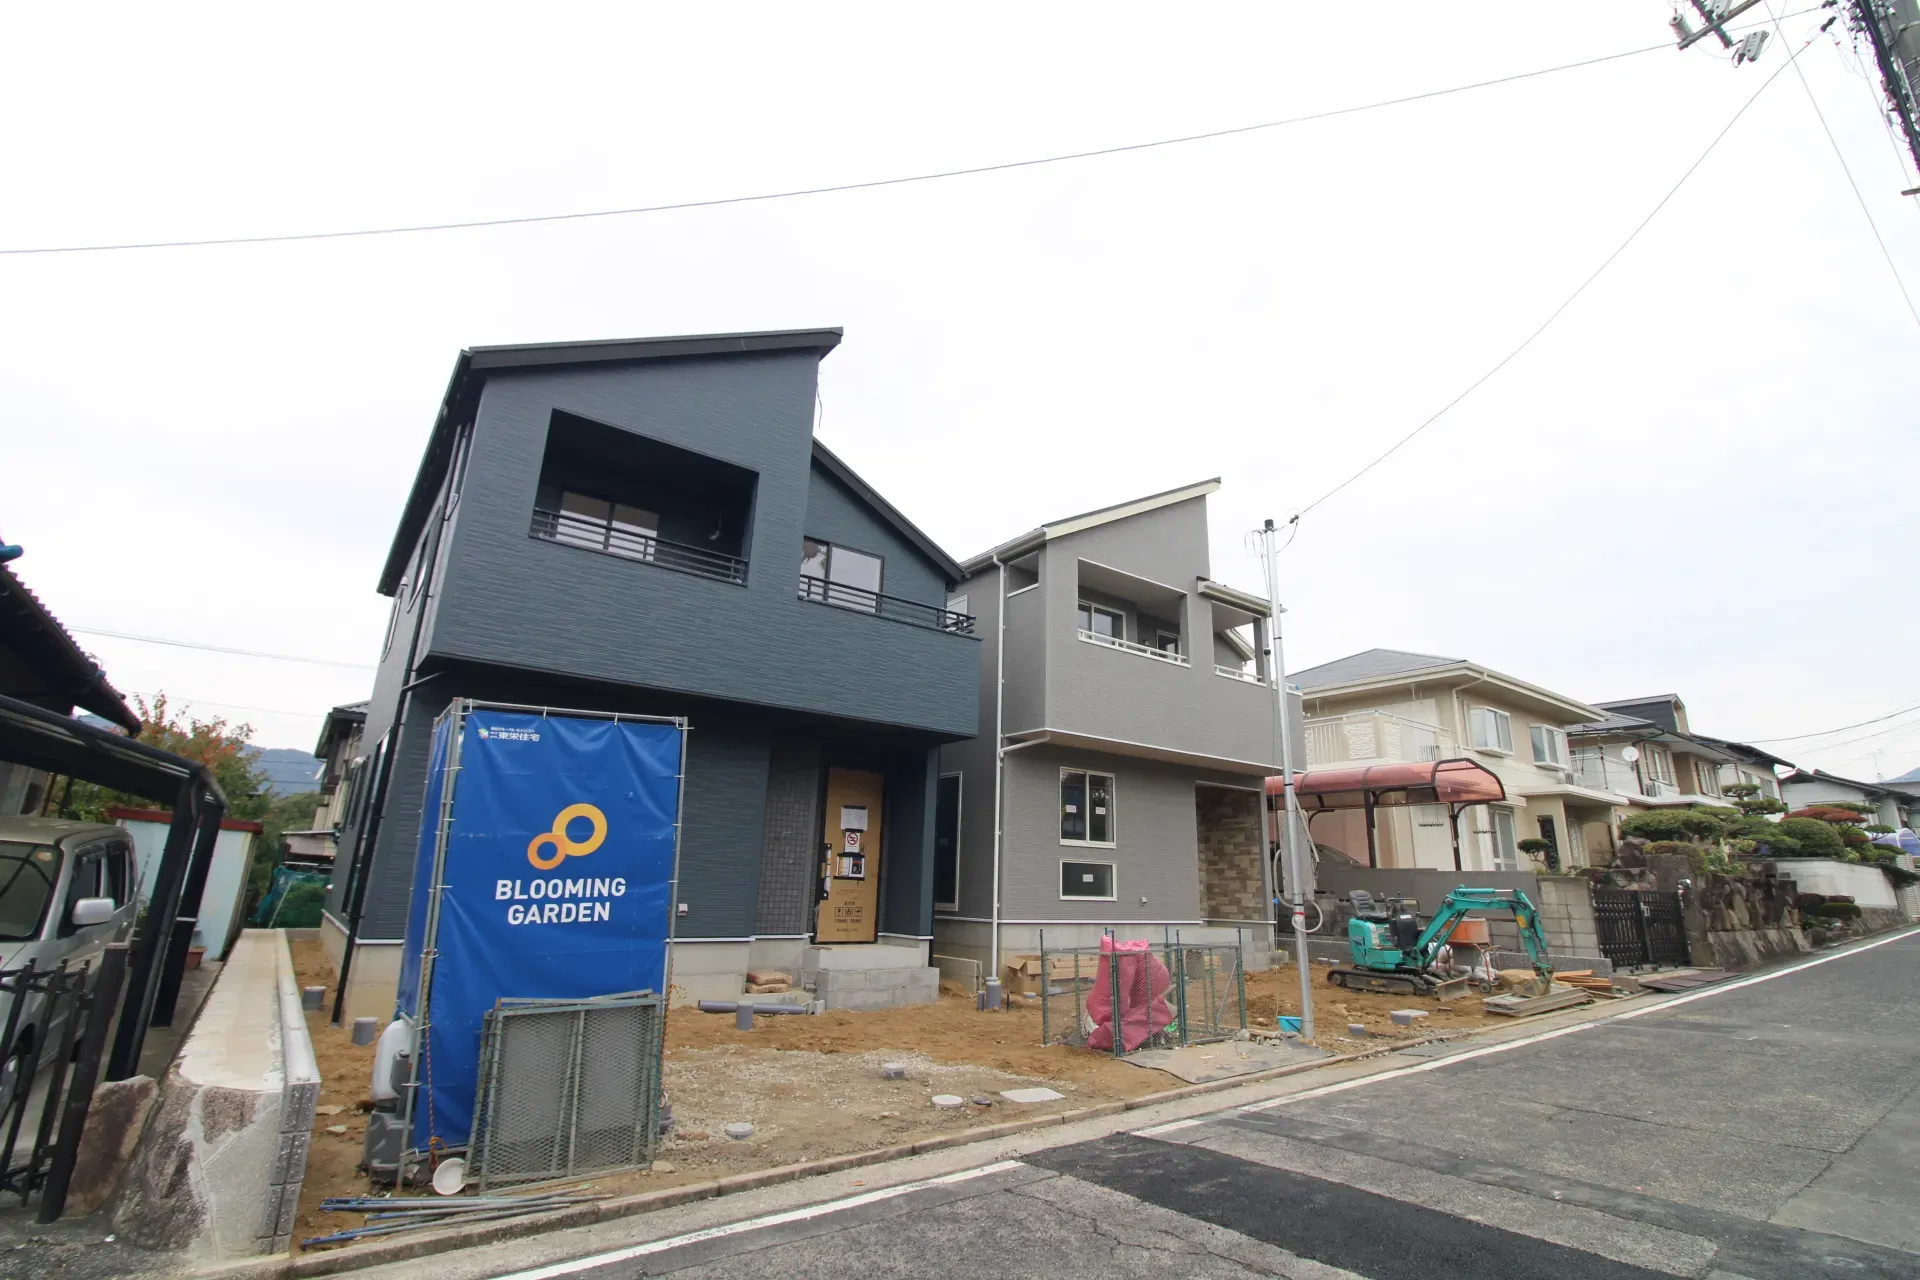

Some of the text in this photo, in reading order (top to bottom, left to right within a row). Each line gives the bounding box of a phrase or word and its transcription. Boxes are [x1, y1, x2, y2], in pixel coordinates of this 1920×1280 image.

[498, 731, 541, 741] 東栄住宅
[495, 877, 626, 900] BLOOMING
[507, 901, 610, 925] GARDEN
